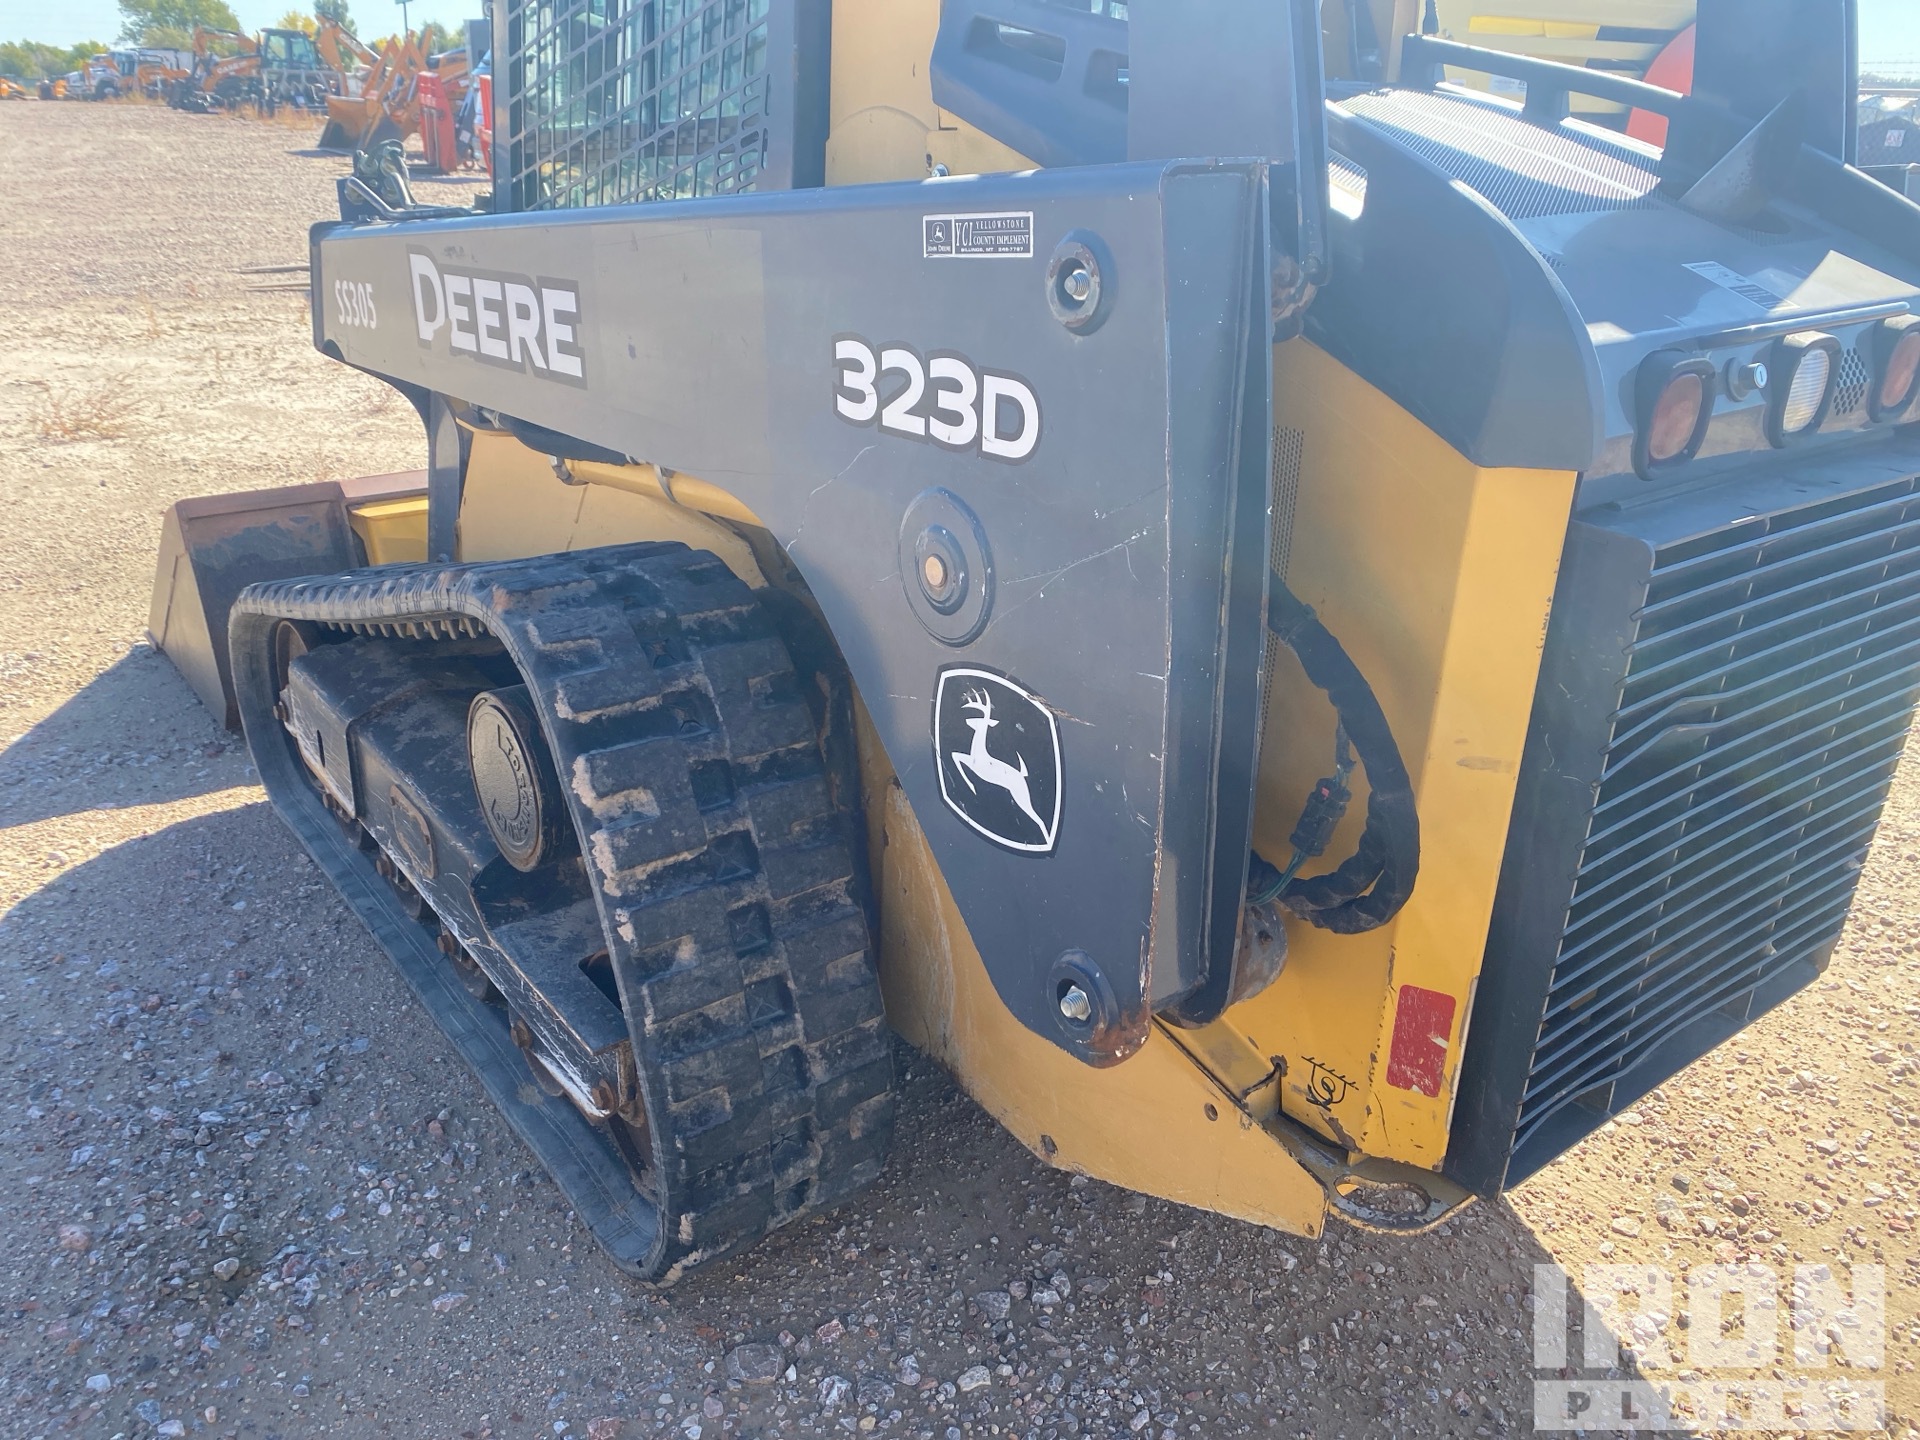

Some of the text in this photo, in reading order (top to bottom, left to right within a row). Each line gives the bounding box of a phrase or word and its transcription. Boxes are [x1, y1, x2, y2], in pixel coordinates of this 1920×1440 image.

[955, 222, 973, 246] YCI
[973, 235, 1029, 245] COUNTY IMPLEMENT
[975, 219, 1024, 229] YELLOWSTONE
[335, 279, 377, 330] SS305
[409, 253, 583, 378] DEERE
[835, 339, 1039, 458] 323D
